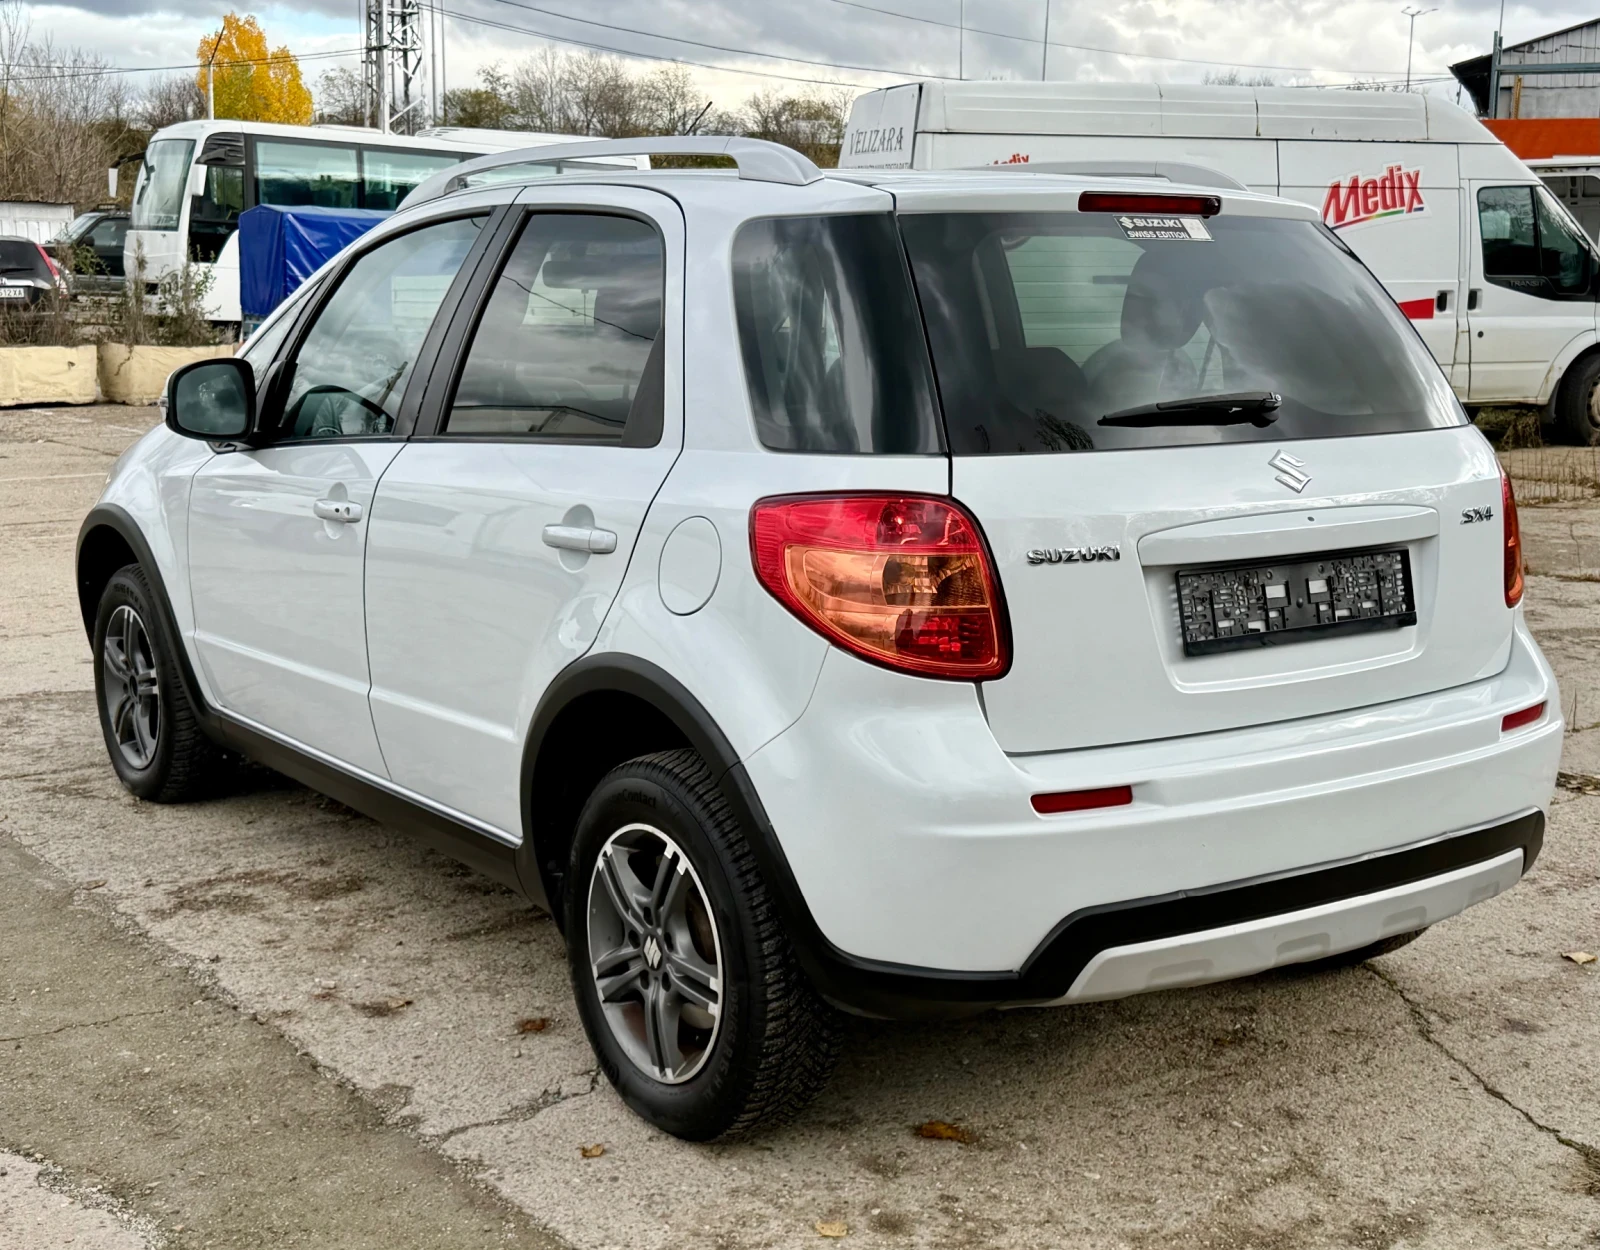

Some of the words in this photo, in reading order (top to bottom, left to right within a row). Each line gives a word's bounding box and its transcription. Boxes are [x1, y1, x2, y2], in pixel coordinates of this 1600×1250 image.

[849, 127, 905, 155] VELIZARA
[1323, 165, 1424, 225] Medix
[1132, 218, 1182, 228] SUZUKI
[1156, 231, 1190, 239] EDITION
[1510, 280, 1544, 288] TRANSIT
[1460, 504, 1493, 525] SX4
[1027, 545, 1120, 566] SUZUKI
